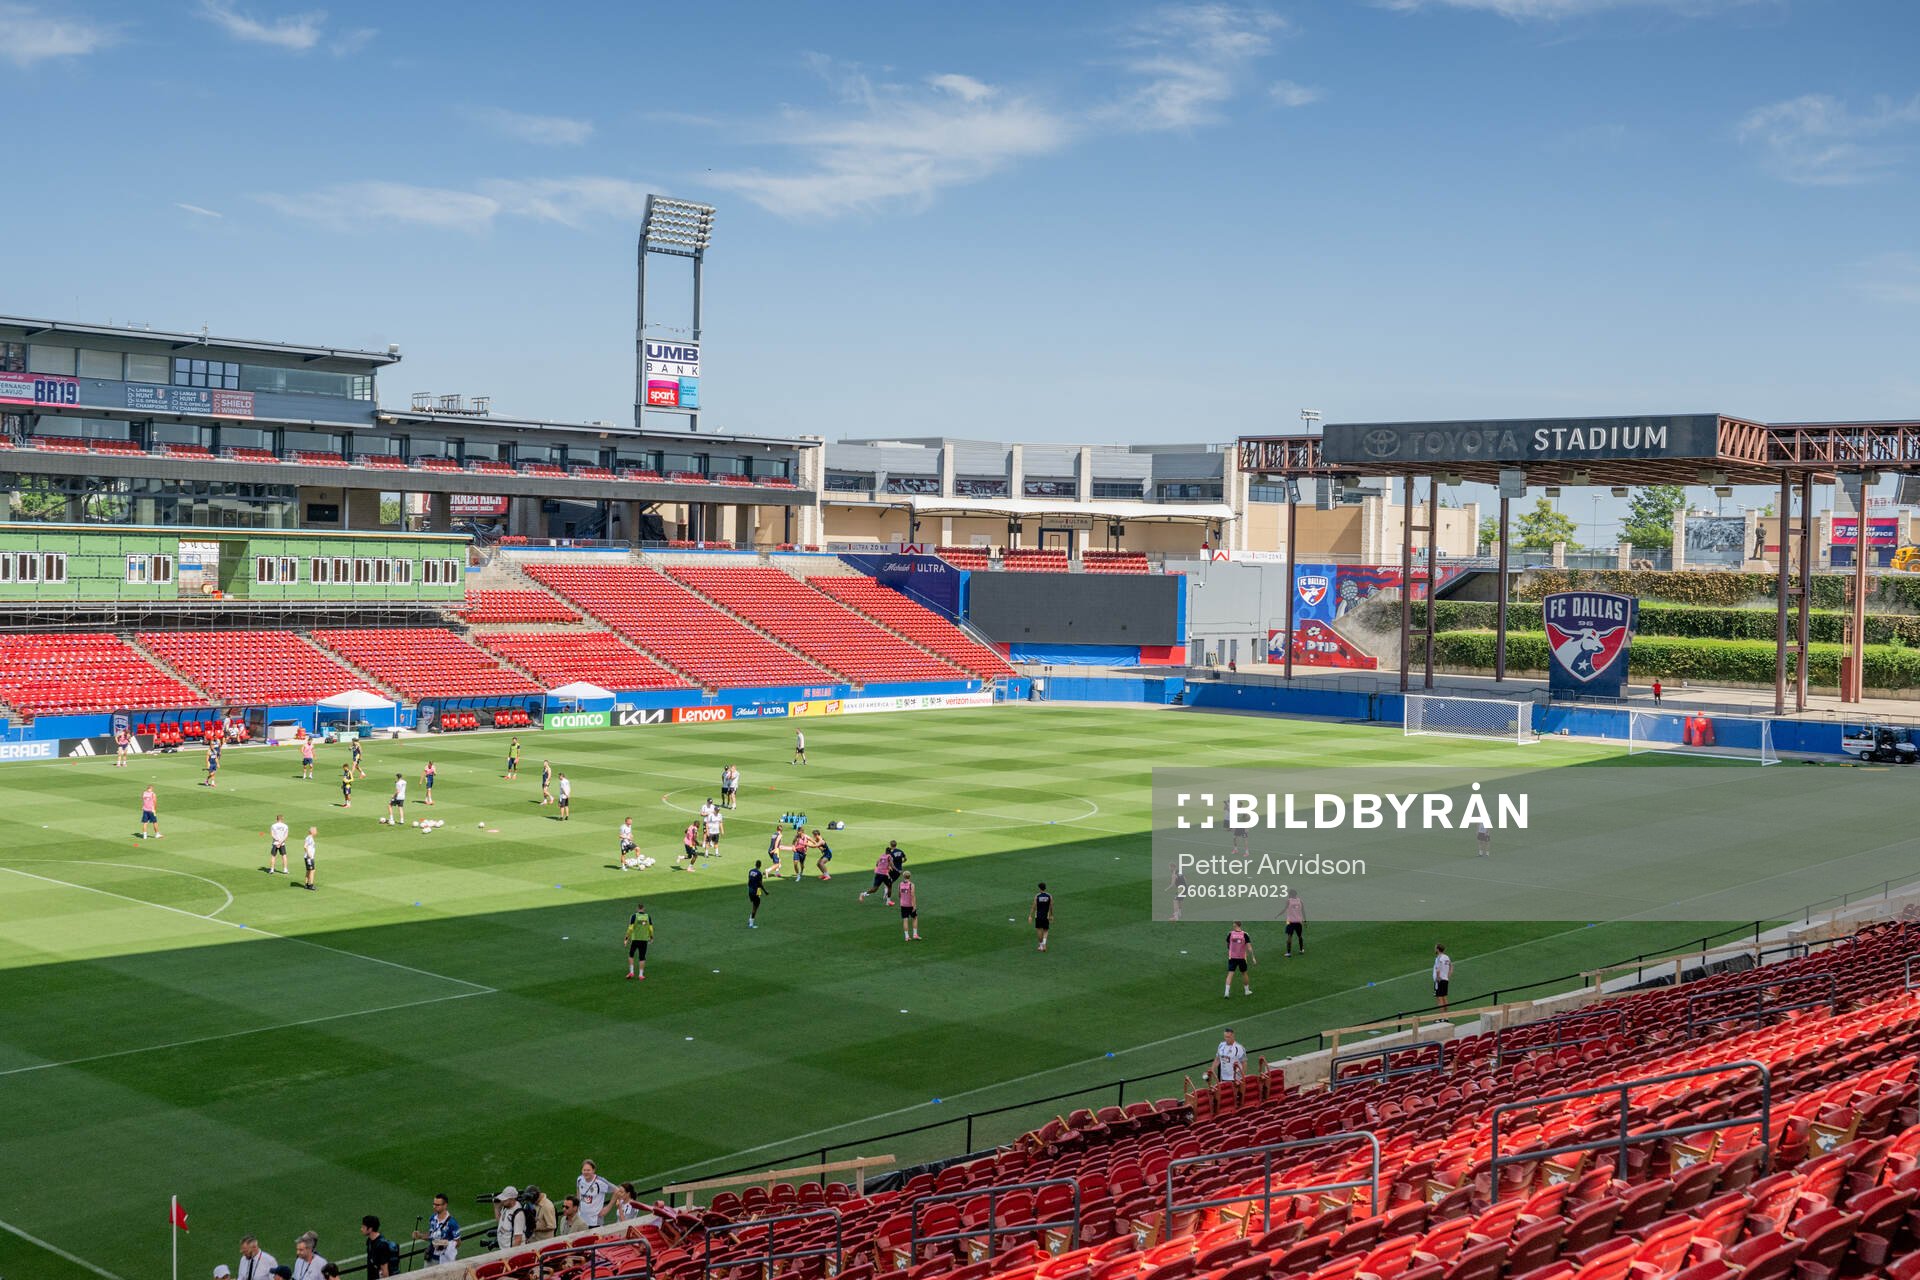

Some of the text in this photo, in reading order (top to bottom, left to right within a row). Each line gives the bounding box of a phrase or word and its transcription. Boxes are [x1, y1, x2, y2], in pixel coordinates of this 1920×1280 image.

[647, 344, 699, 362] UMB
[646, 362, 698, 375] BANK
[35, 380, 77, 404] BR19
[650, 388, 676, 403] spark
[221, 399, 252, 409] SHIELD
[1407, 425, 1667, 454] TOYOTA STADIUM
[917, 563, 946, 573] ULTRA
[1550, 597, 1623, 621] FC DALLAS
[1306, 640, 1338, 653] DTID
[679, 707, 726, 722] Lenovo
[763, 706, 785, 715] ULTRA
[551, 713, 604, 728] aramco
[0, 743, 51, 758] ERADE
